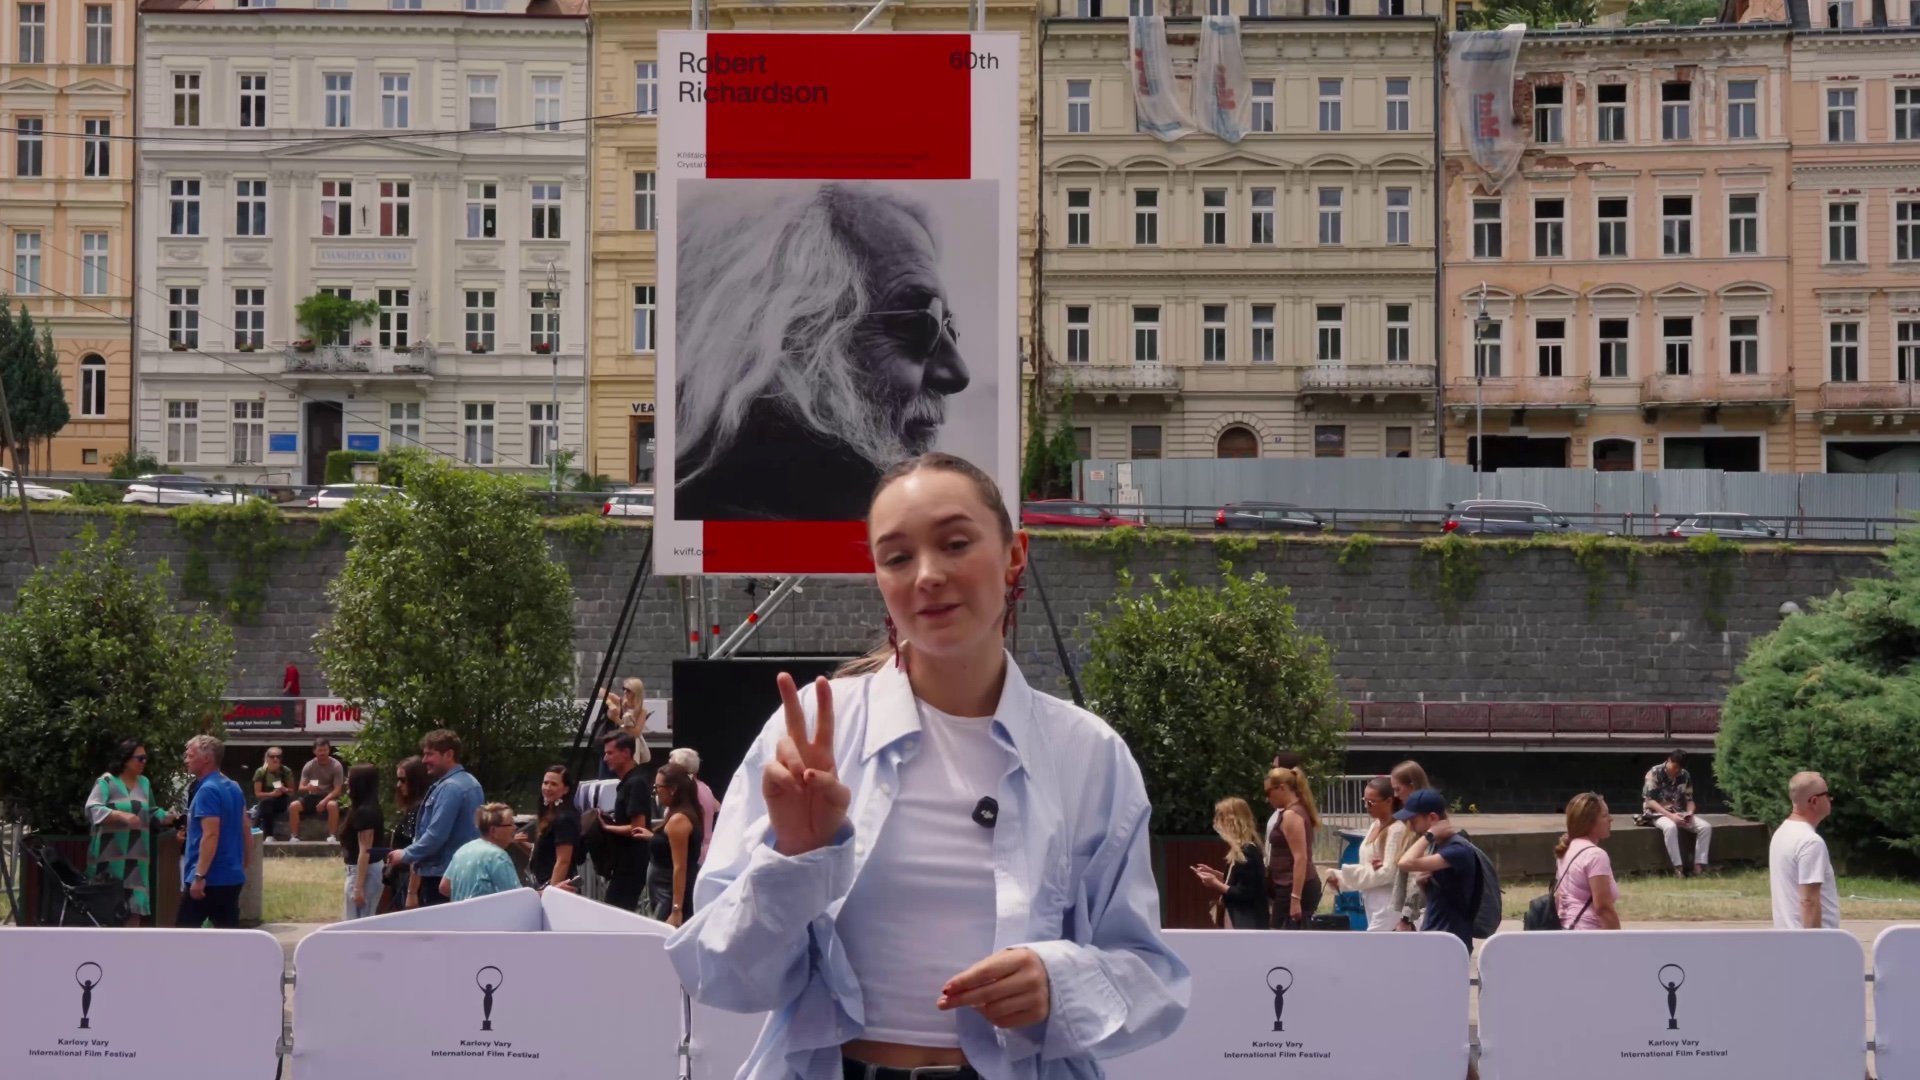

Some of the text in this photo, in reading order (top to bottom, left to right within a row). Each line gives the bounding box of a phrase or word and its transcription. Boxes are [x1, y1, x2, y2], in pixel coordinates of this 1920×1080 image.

[679, 51, 766, 74] Robert
[950, 51, 999, 70] 60th
[678, 80, 829, 103] Richardson
[57, 1039, 109, 1048] Karlovy Vary
[460, 1040, 491, 1048] Karlovy
[1648, 1039, 1700, 1048] Karlovy Vary
[29, 1049, 136, 1058] International Film Festival
[431, 1050, 540, 1060] International Film Festival
[1675, 1050, 1693, 1058] Film
[1695, 1049, 1728, 1058] Festival
